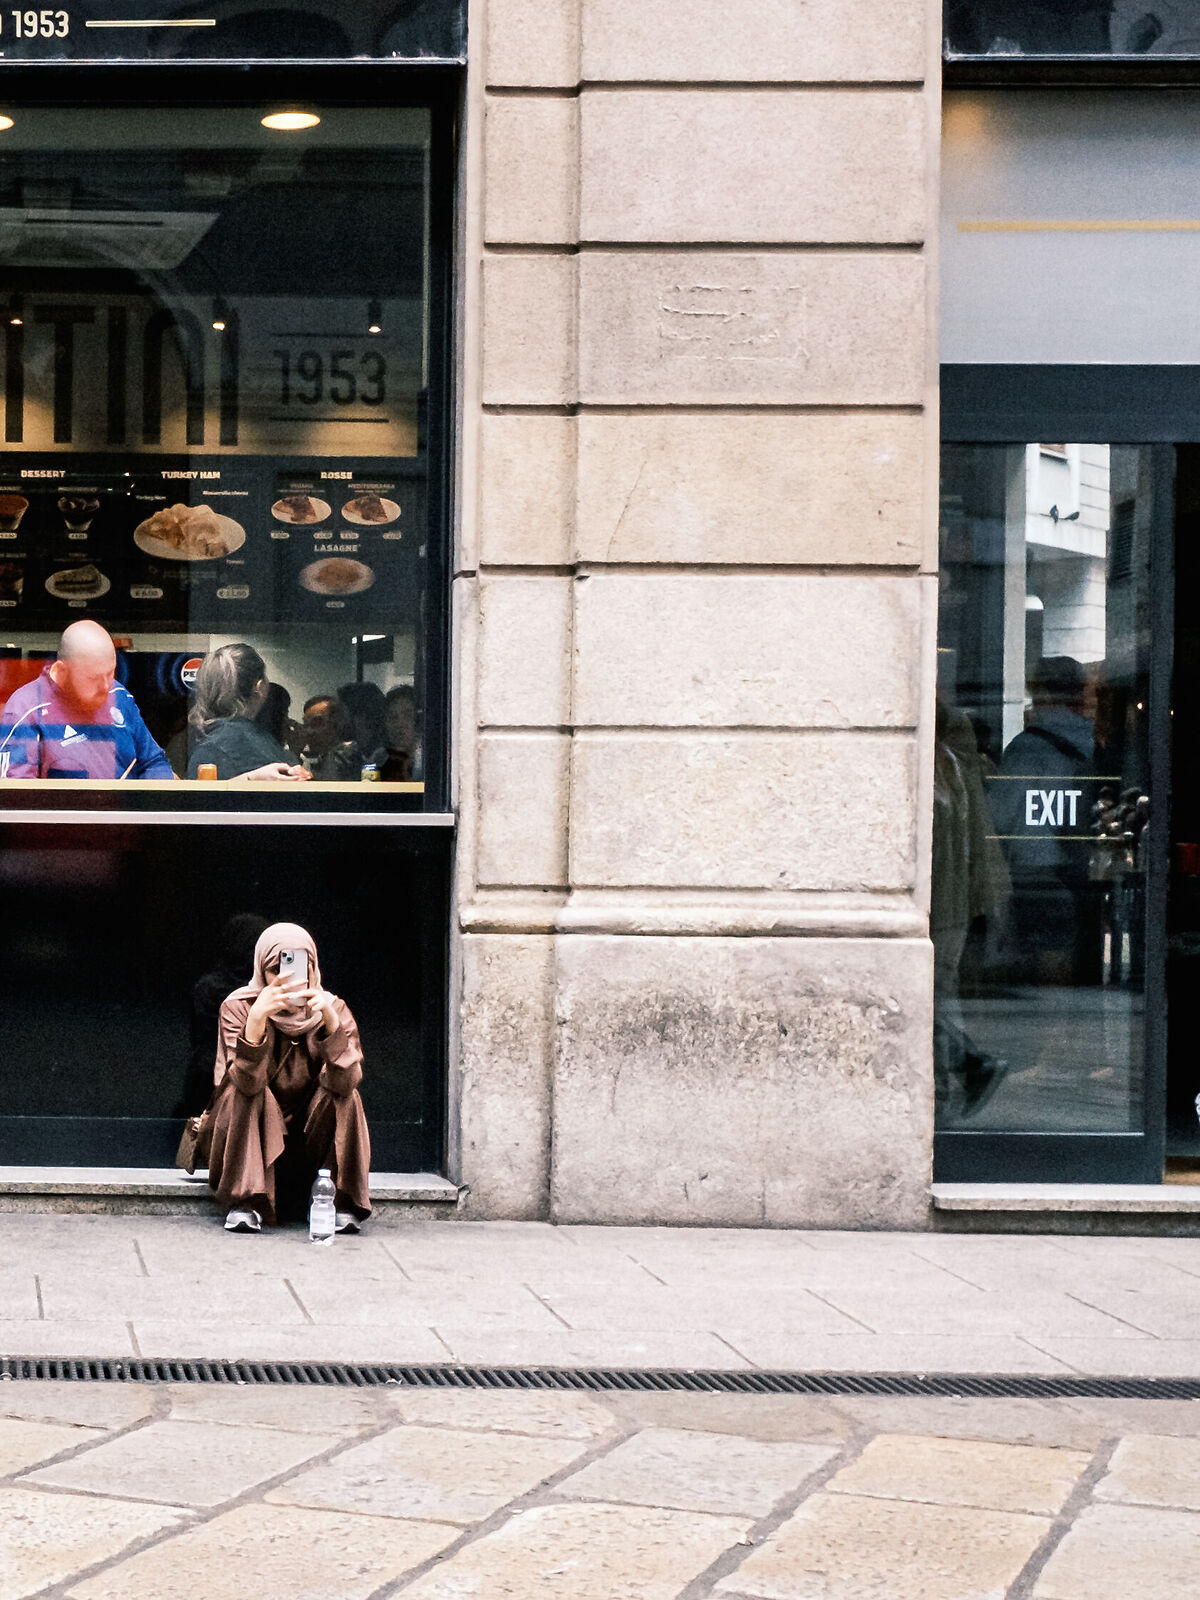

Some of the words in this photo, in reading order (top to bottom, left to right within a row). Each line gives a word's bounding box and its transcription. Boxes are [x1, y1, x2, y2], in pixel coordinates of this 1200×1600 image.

[12, 10, 69, 38] 1953
[272, 348, 387, 407] 1953
[20, 470, 67, 478] DESSERT
[160, 471, 199, 480] TURKEY
[199, 471, 221, 480] HAM
[320, 471, 353, 480] ROSSE
[313, 544, 359, 553] LASAGNE
[1025, 789, 1082, 827] EXIT
